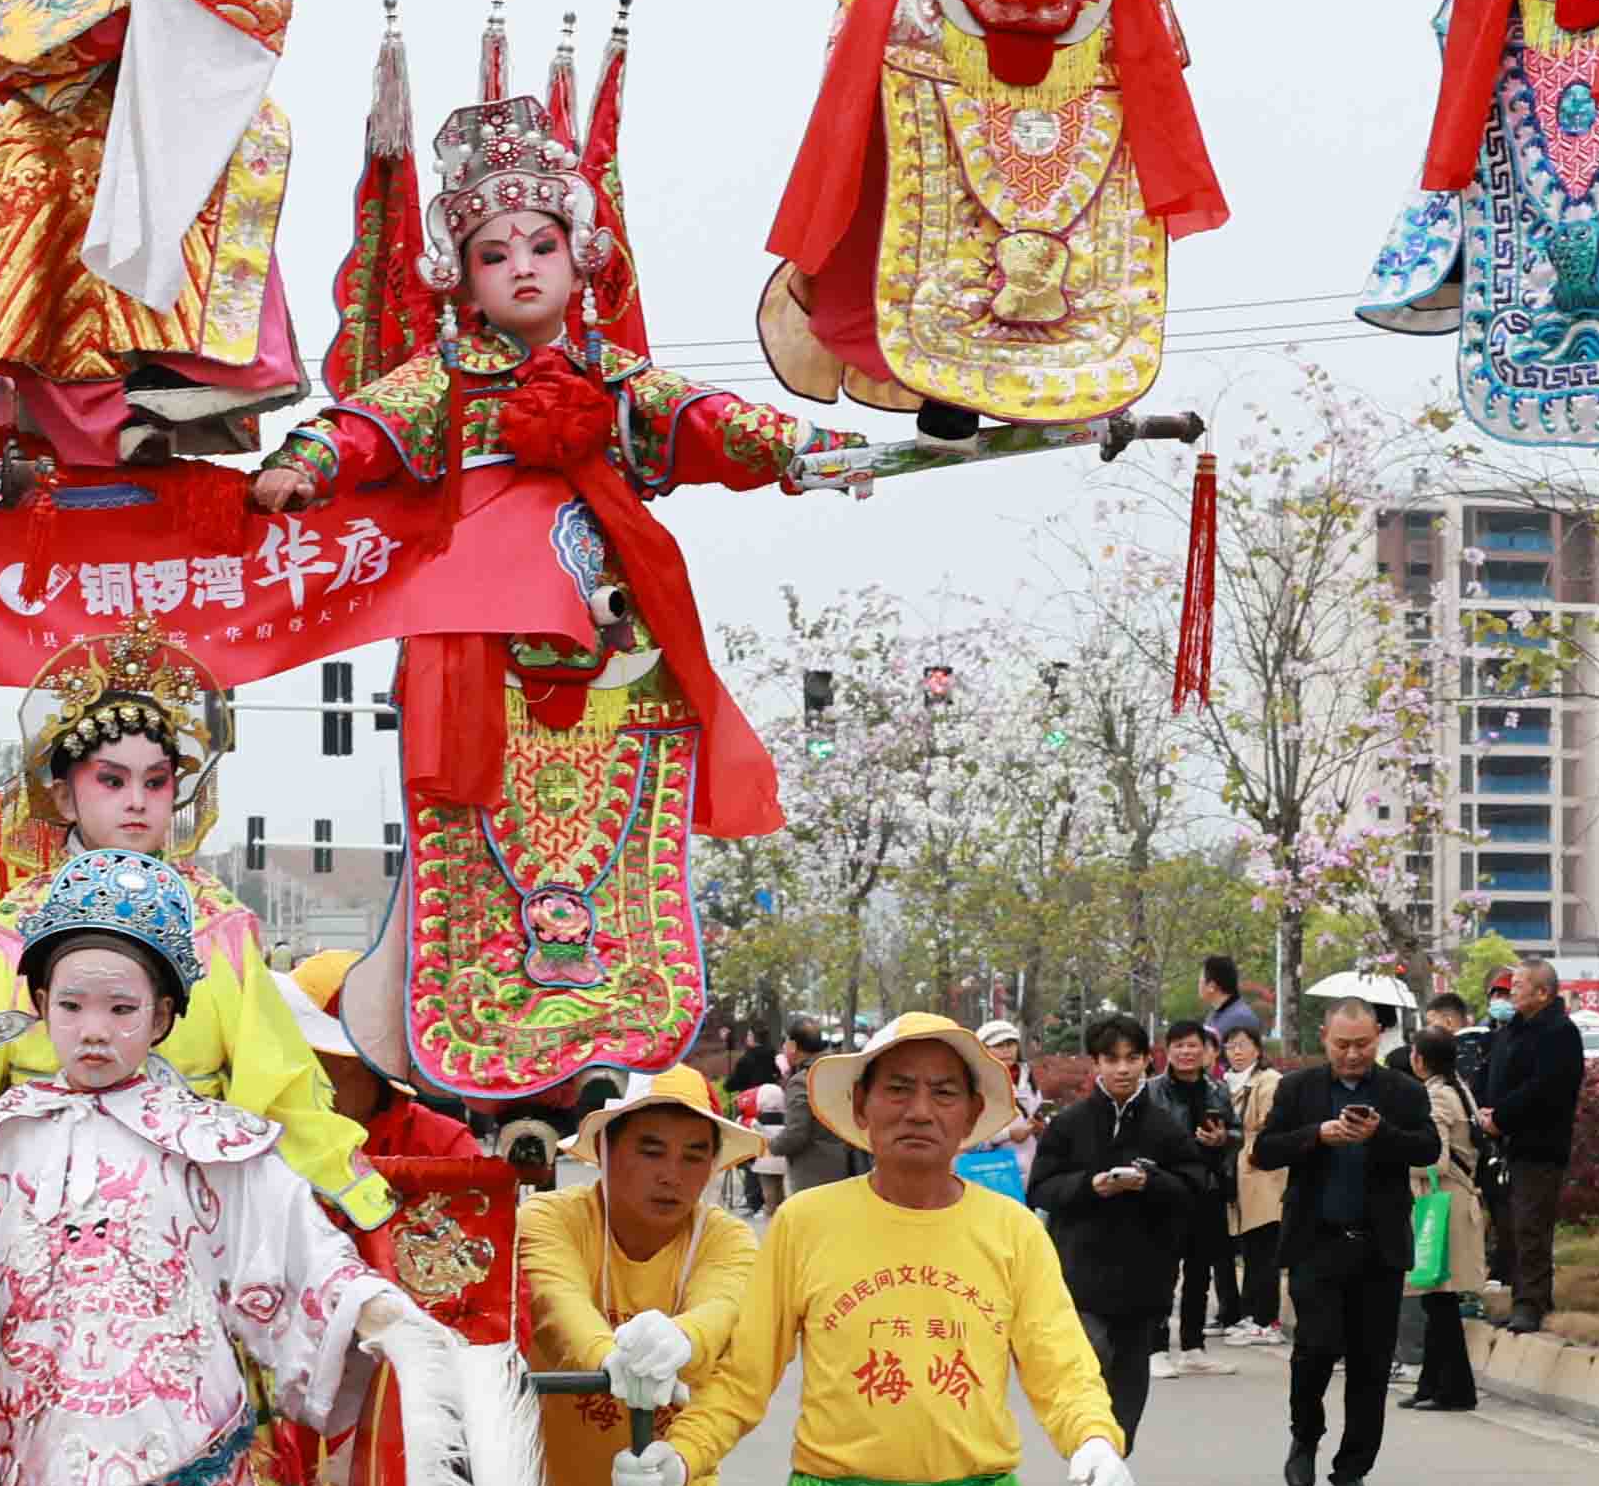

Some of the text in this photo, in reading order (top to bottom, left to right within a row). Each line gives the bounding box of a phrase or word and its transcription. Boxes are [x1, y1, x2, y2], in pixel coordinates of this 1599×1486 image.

[78, 515, 403, 617] 铜锣湾华府
[869, 1316, 967, 1340] 广东 吴川
[851, 1347, 984, 1411] 梅岭
